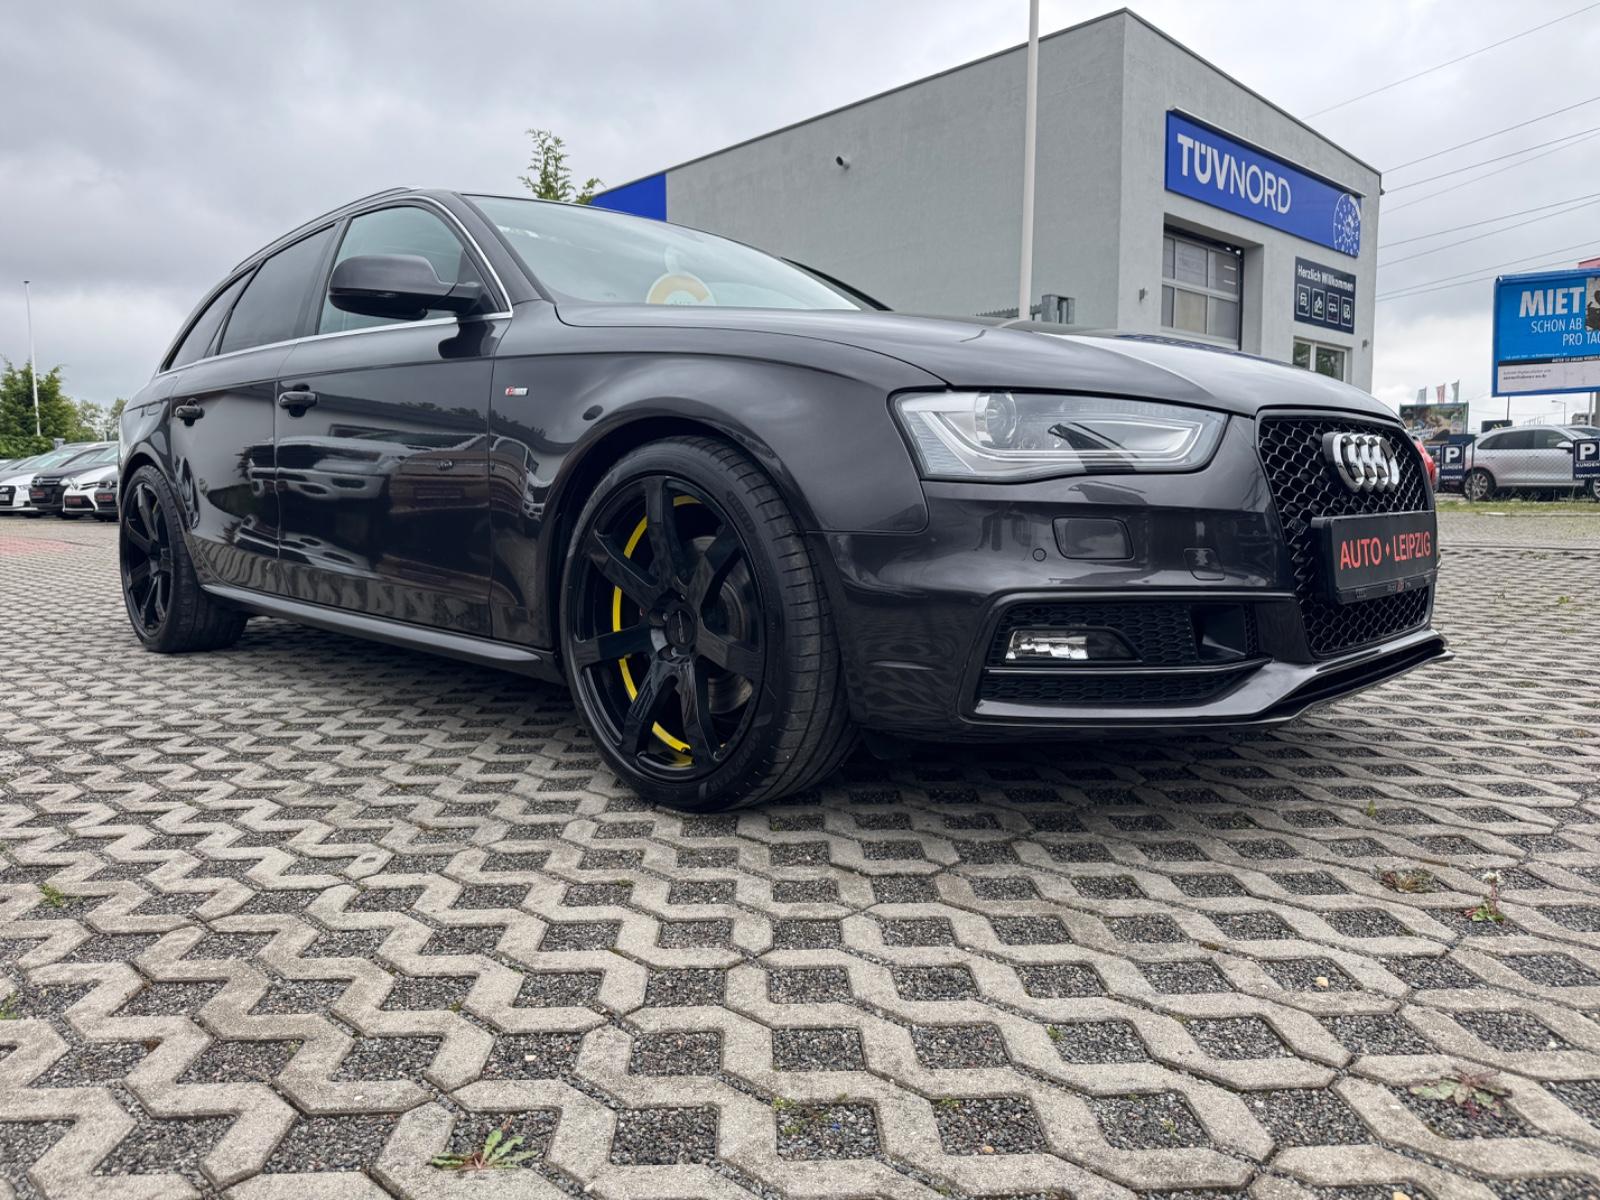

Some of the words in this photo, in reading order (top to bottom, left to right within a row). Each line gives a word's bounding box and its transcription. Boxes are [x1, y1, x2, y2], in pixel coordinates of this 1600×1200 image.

[1297, 264, 1321, 283] Herzlich
[1321, 271, 1354, 292] Willkommen
[1519, 286, 1585, 318] MIET
[1531, 319, 1565, 333] SCHON
[1568, 317, 1582, 331] AB
[1562, 332, 1582, 347] PRO
[1445, 446, 1460, 463] P
[1580, 443, 1596, 460] P
[1341, 537, 1382, 570] AUTO
[1393, 531, 1431, 562] LEIPZIG
